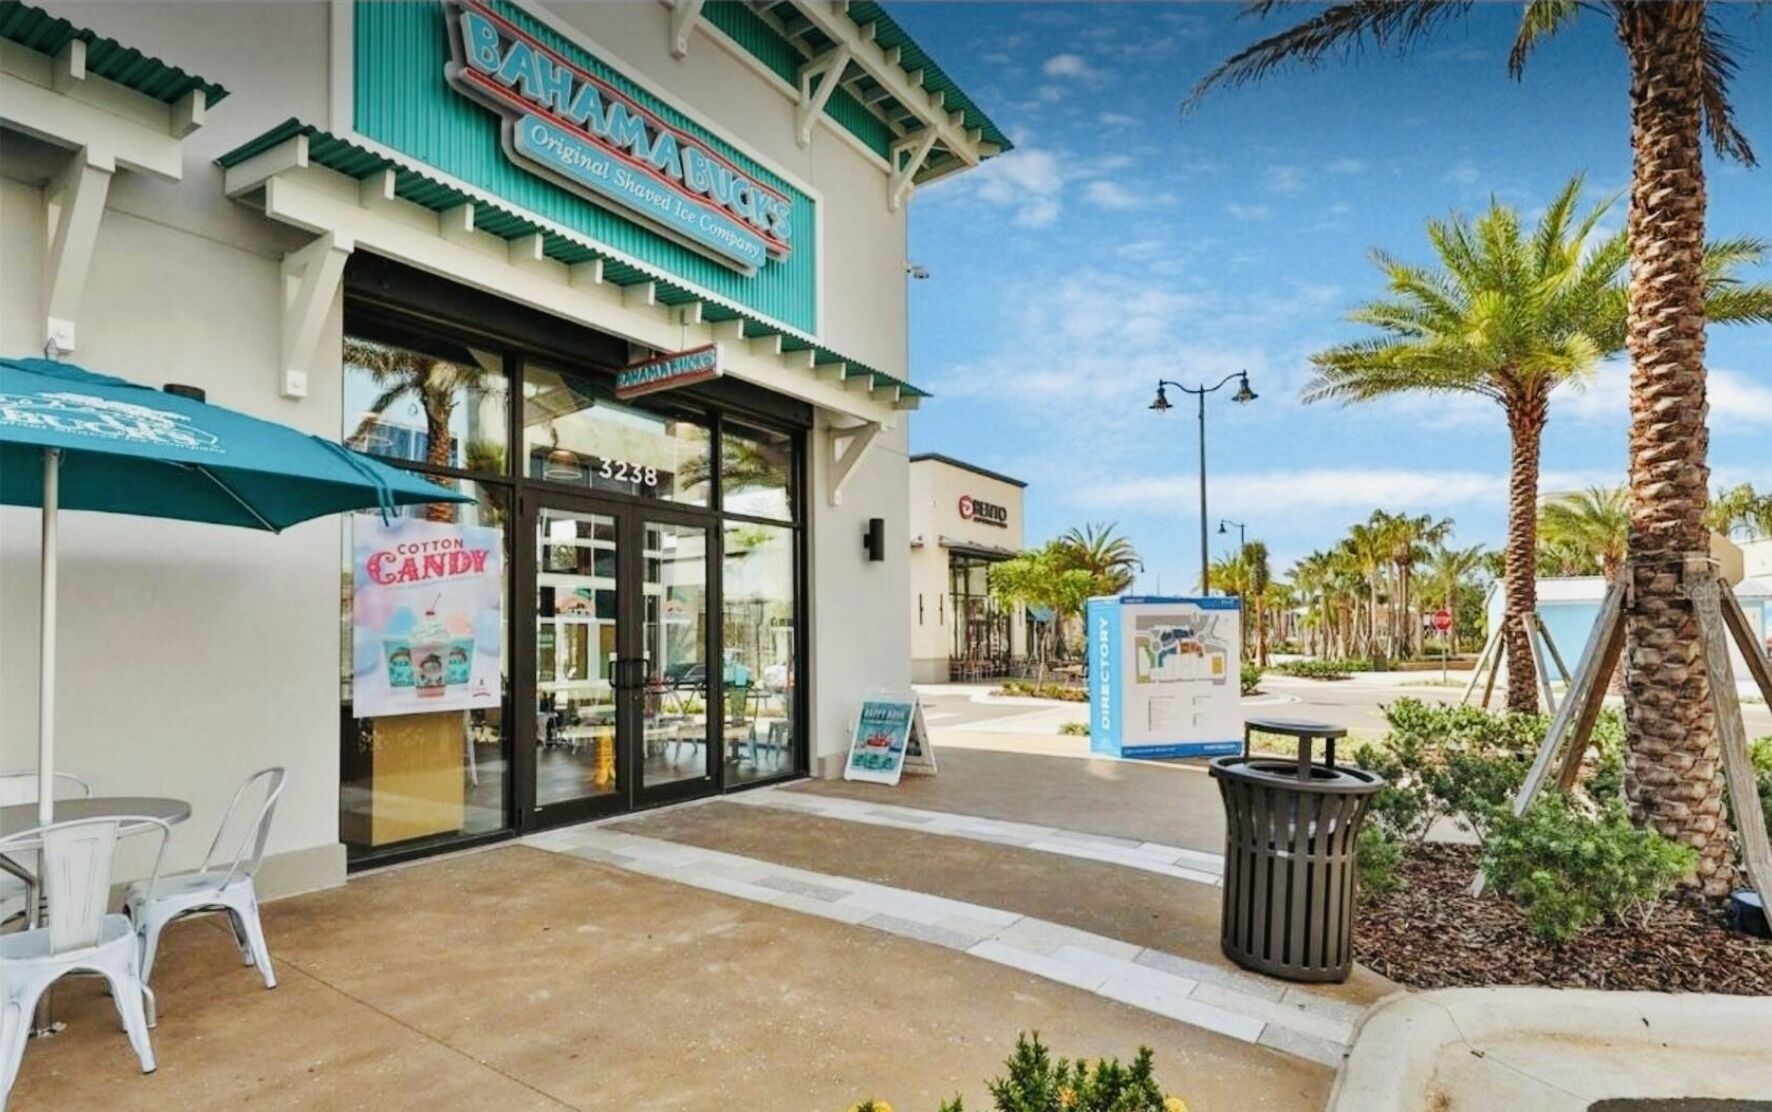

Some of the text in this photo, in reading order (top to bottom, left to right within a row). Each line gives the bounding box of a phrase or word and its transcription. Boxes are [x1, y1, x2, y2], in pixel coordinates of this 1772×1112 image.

[460, 10, 792, 239] BAHAMA BUCK'S
[530, 124, 761, 258] Original Shaved Ice Company
[598, 456, 658, 487] 3238
[366, 549, 490, 586] CANDY
[397, 538, 464, 555] COTTON
[1099, 617, 1111, 730] DIRECTORY
